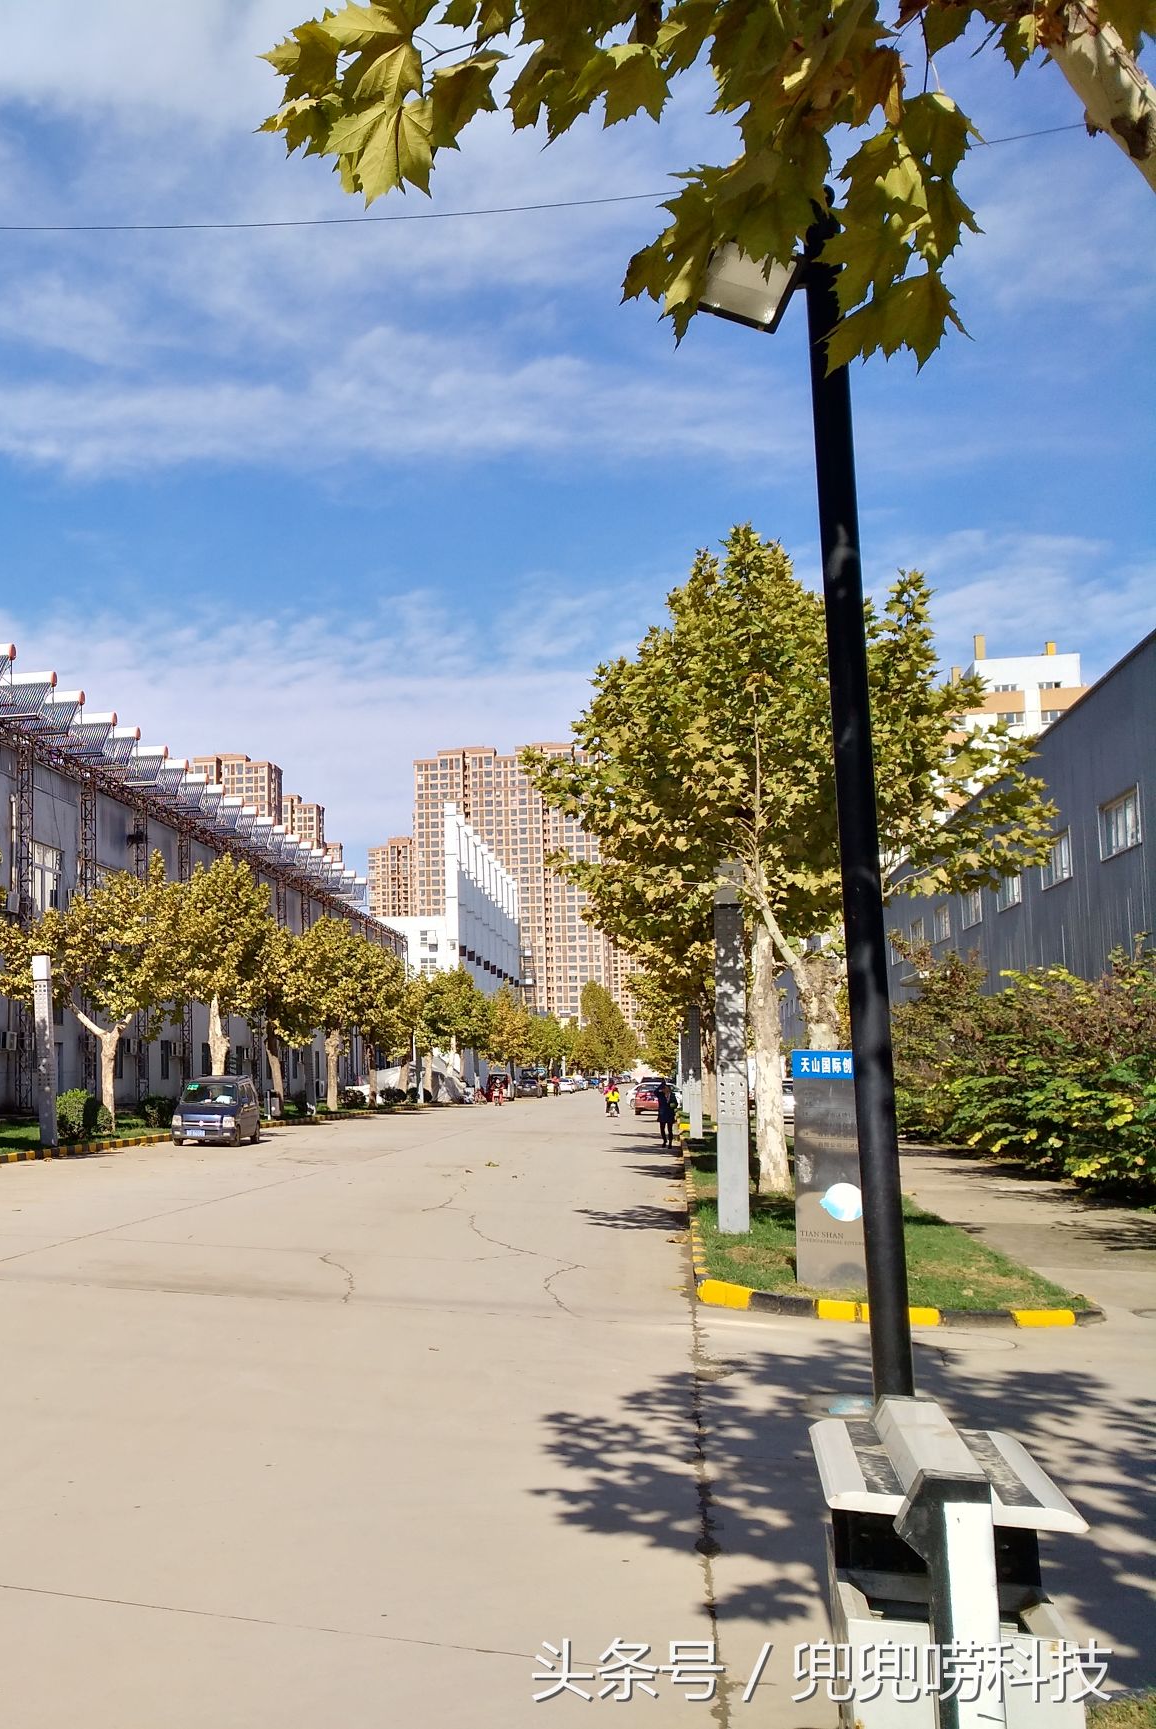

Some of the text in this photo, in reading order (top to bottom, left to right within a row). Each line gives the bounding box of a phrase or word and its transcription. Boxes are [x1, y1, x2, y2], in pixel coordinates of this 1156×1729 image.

[800, 1057, 852, 1074] 天山国际创
[799, 1230, 844, 1239] TIAN SHAN
